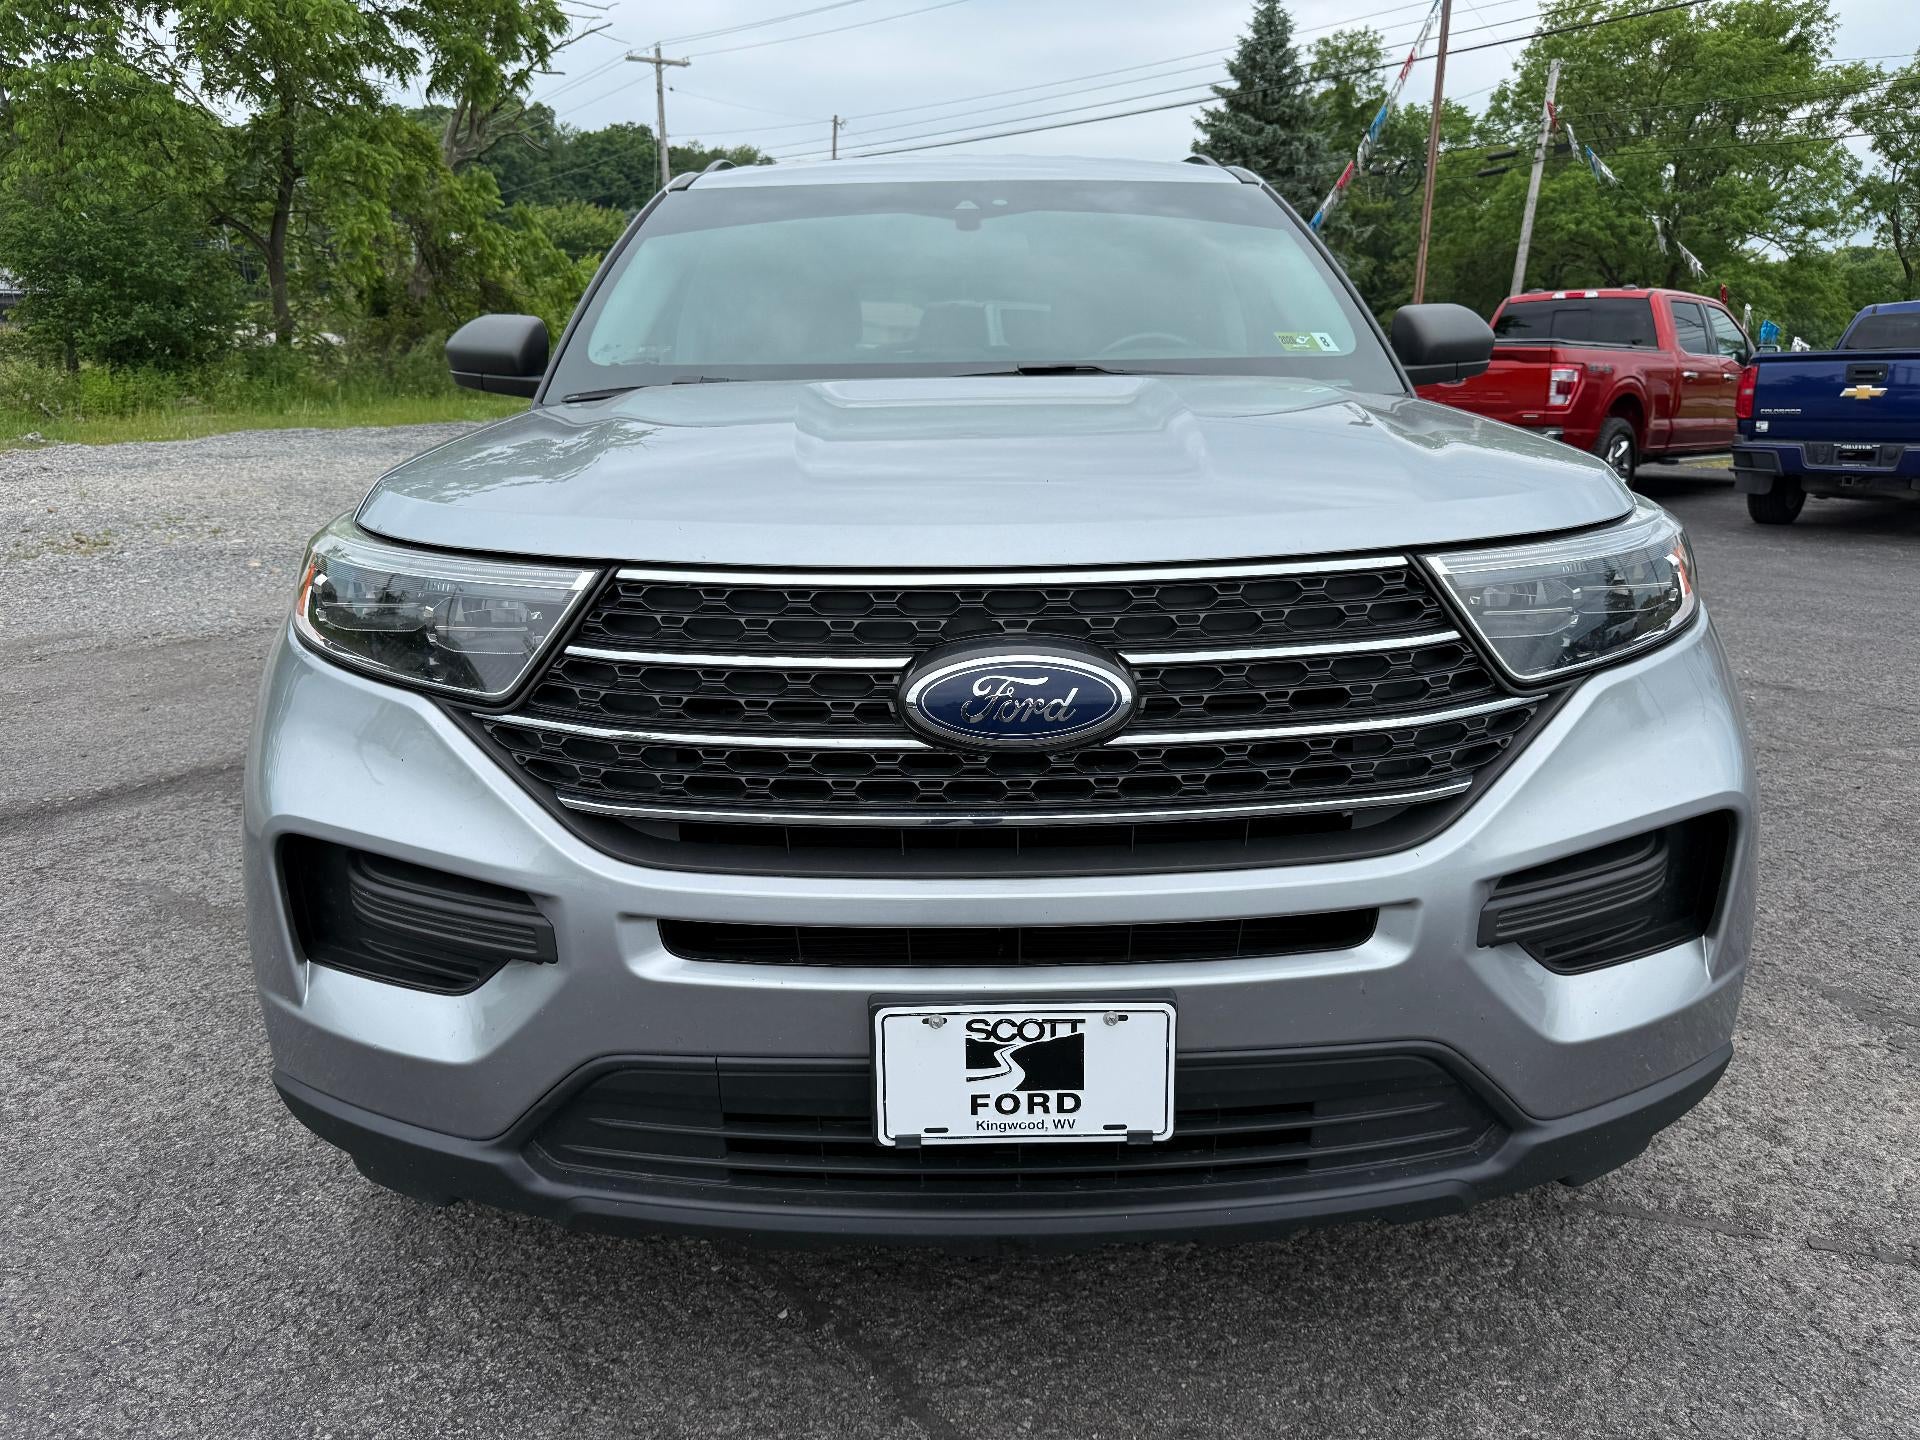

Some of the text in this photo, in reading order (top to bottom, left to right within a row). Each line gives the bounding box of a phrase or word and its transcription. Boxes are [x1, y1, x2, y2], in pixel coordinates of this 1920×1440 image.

[961, 675, 1079, 724] Ford
[965, 1018, 1086, 1042] SCOTT
[970, 1093, 1082, 1115] FORD
[976, 1119, 1076, 1132] Kingwood, WV
